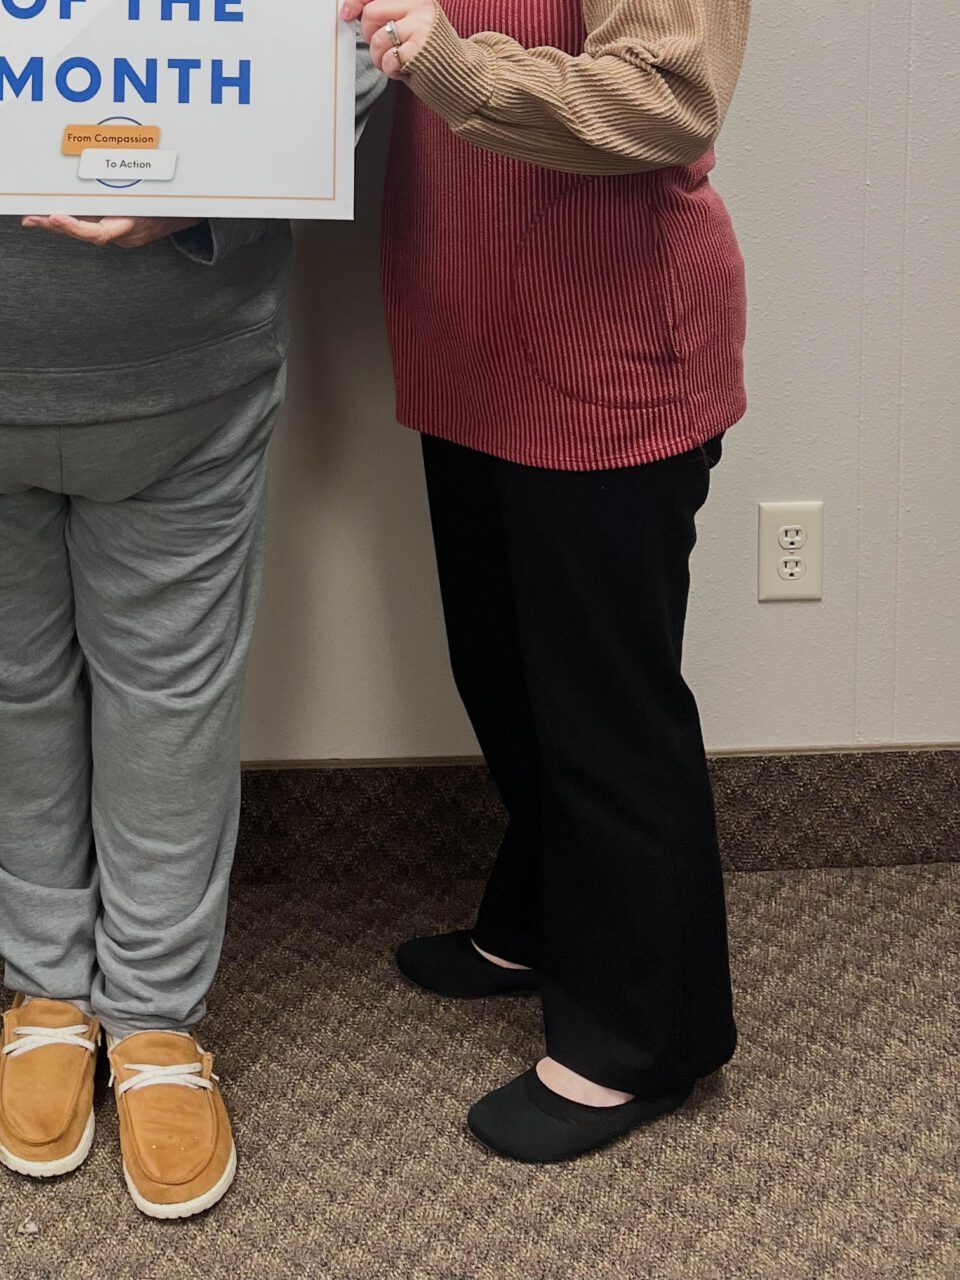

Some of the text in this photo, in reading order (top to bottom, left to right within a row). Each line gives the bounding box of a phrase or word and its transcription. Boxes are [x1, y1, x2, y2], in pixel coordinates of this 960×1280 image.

[67, 133, 154, 145] From Compassion
[105, 159, 152, 169] To Action
